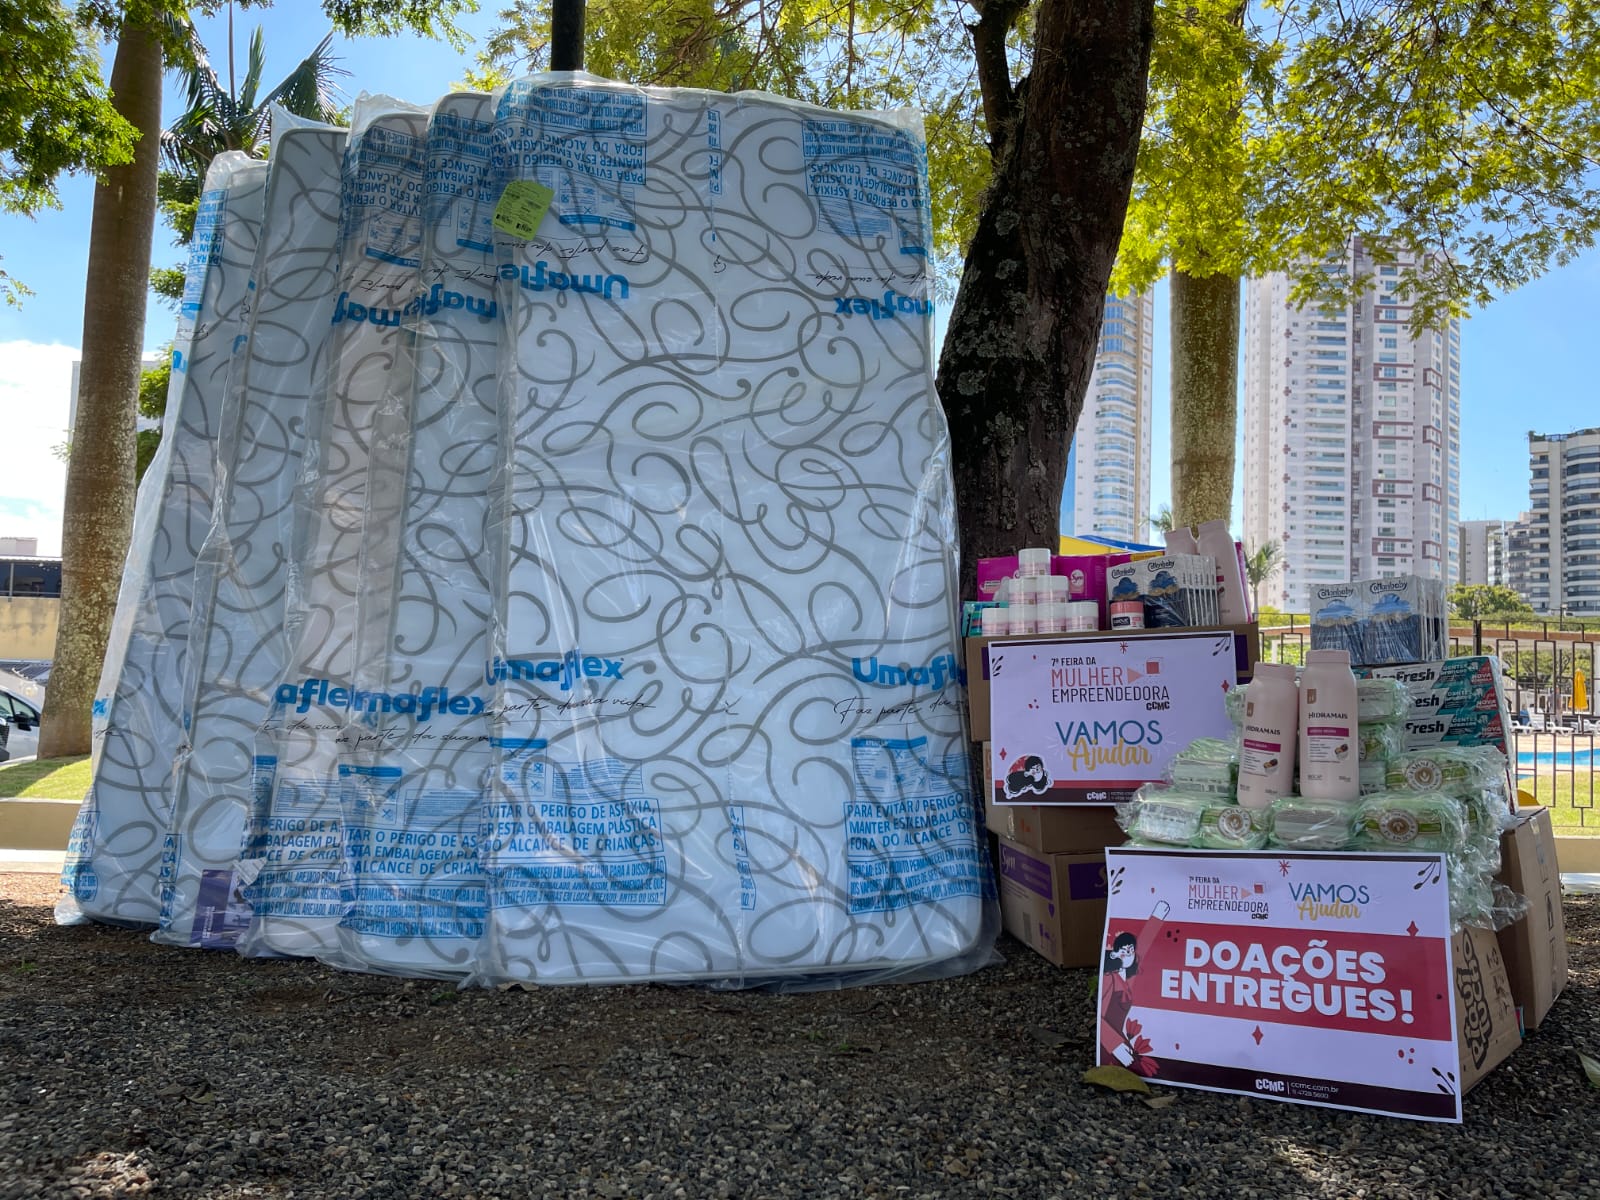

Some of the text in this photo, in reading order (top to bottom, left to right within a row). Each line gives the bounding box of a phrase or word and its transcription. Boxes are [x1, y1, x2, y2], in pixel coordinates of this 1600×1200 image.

[520, 127, 642, 156] FORA DO ALCANCE DE
[510, 140, 643, 168] MANTER ESTA EMBALAGEM
[523, 154, 561, 166] PERIGO
[442, 160, 489, 176] ALCANCE
[566, 160, 574, 168] O
[578, 163, 612, 179] EVITAR
[808, 162, 860, 174] CRIANÇAS.
[866, 166, 878, 176] DE
[616, 170, 643, 182] PARA
[809, 174, 852, 187] PLÁSTICA
[810, 184, 850, 198] ASFIXIA,
[855, 175, 906, 195] EMBALAGEM
[390, 187, 410, 203] ESTA
[467, 188, 475, 199] O
[854, 189, 864, 201] DE
[866, 192, 898, 208] PERIGO
[901, 199, 909, 208] O
[496, 261, 630, 299] Umafle
[1061, 657, 1083, 666] FEIRA
[1086, 656, 1097, 665] DA
[852, 654, 967, 692] Umafl
[1051, 667, 1123, 687] MULHER
[1052, 685, 1170, 703] EMPREENDEDORA
[1146, 701, 1170, 711] CCMC
[1308, 712, 1348, 720] HIDRAMAIS
[1055, 720, 1163, 746] VAMOS
[1245, 725, 1281, 736] HIDRAMAIS
[1067, 737, 1152, 772] Ajudar
[527, 805, 536, 817] O
[541, 803, 587, 819] PERIGO
[592, 803, 606, 819] DE
[609, 799, 656, 817] ASFIXIA,
[847, 804, 873, 818] PARA
[876, 800, 913, 817] EVITAR
[923, 792, 964, 812] PERIGO
[310, 820, 325, 832] DE
[499, 815, 657, 836] ESTA EMBALAGEM PLÁSTICA
[849, 821, 891, 835] MANTER
[375, 831, 385, 843] O
[390, 832, 436, 846] PERIGO
[441, 834, 456, 847] DE
[508, 838, 565, 853] ALCANCE
[573, 838, 589, 851] DE
[597, 833, 659, 851] CRIANÇAS.
[850, 837, 877, 851] FORA
[883, 834, 900, 848] DO
[904, 825, 952, 846] ALCANCE
[288, 850, 305, 861] DE
[375, 846, 453, 861] EMBALAGEM
[354, 861, 412, 874] ALCANCE
[420, 862, 436, 875] DE
[1195, 876, 1211, 884] FEIRA
[1188, 884, 1238, 899] MULHER
[1288, 882, 1370, 905] VAMOS
[1188, 898, 1269, 913] EMPREENDEDORA
[1297, 896, 1361, 921] Ajudar
[1184, 938, 1386, 985] DOAÇÕES
[1161, 969, 1415, 1024] ENTREGUES!
[1255, 1079, 1284, 1092] CCMC
[1290, 1082, 1339, 1093] ccmc.com.br
